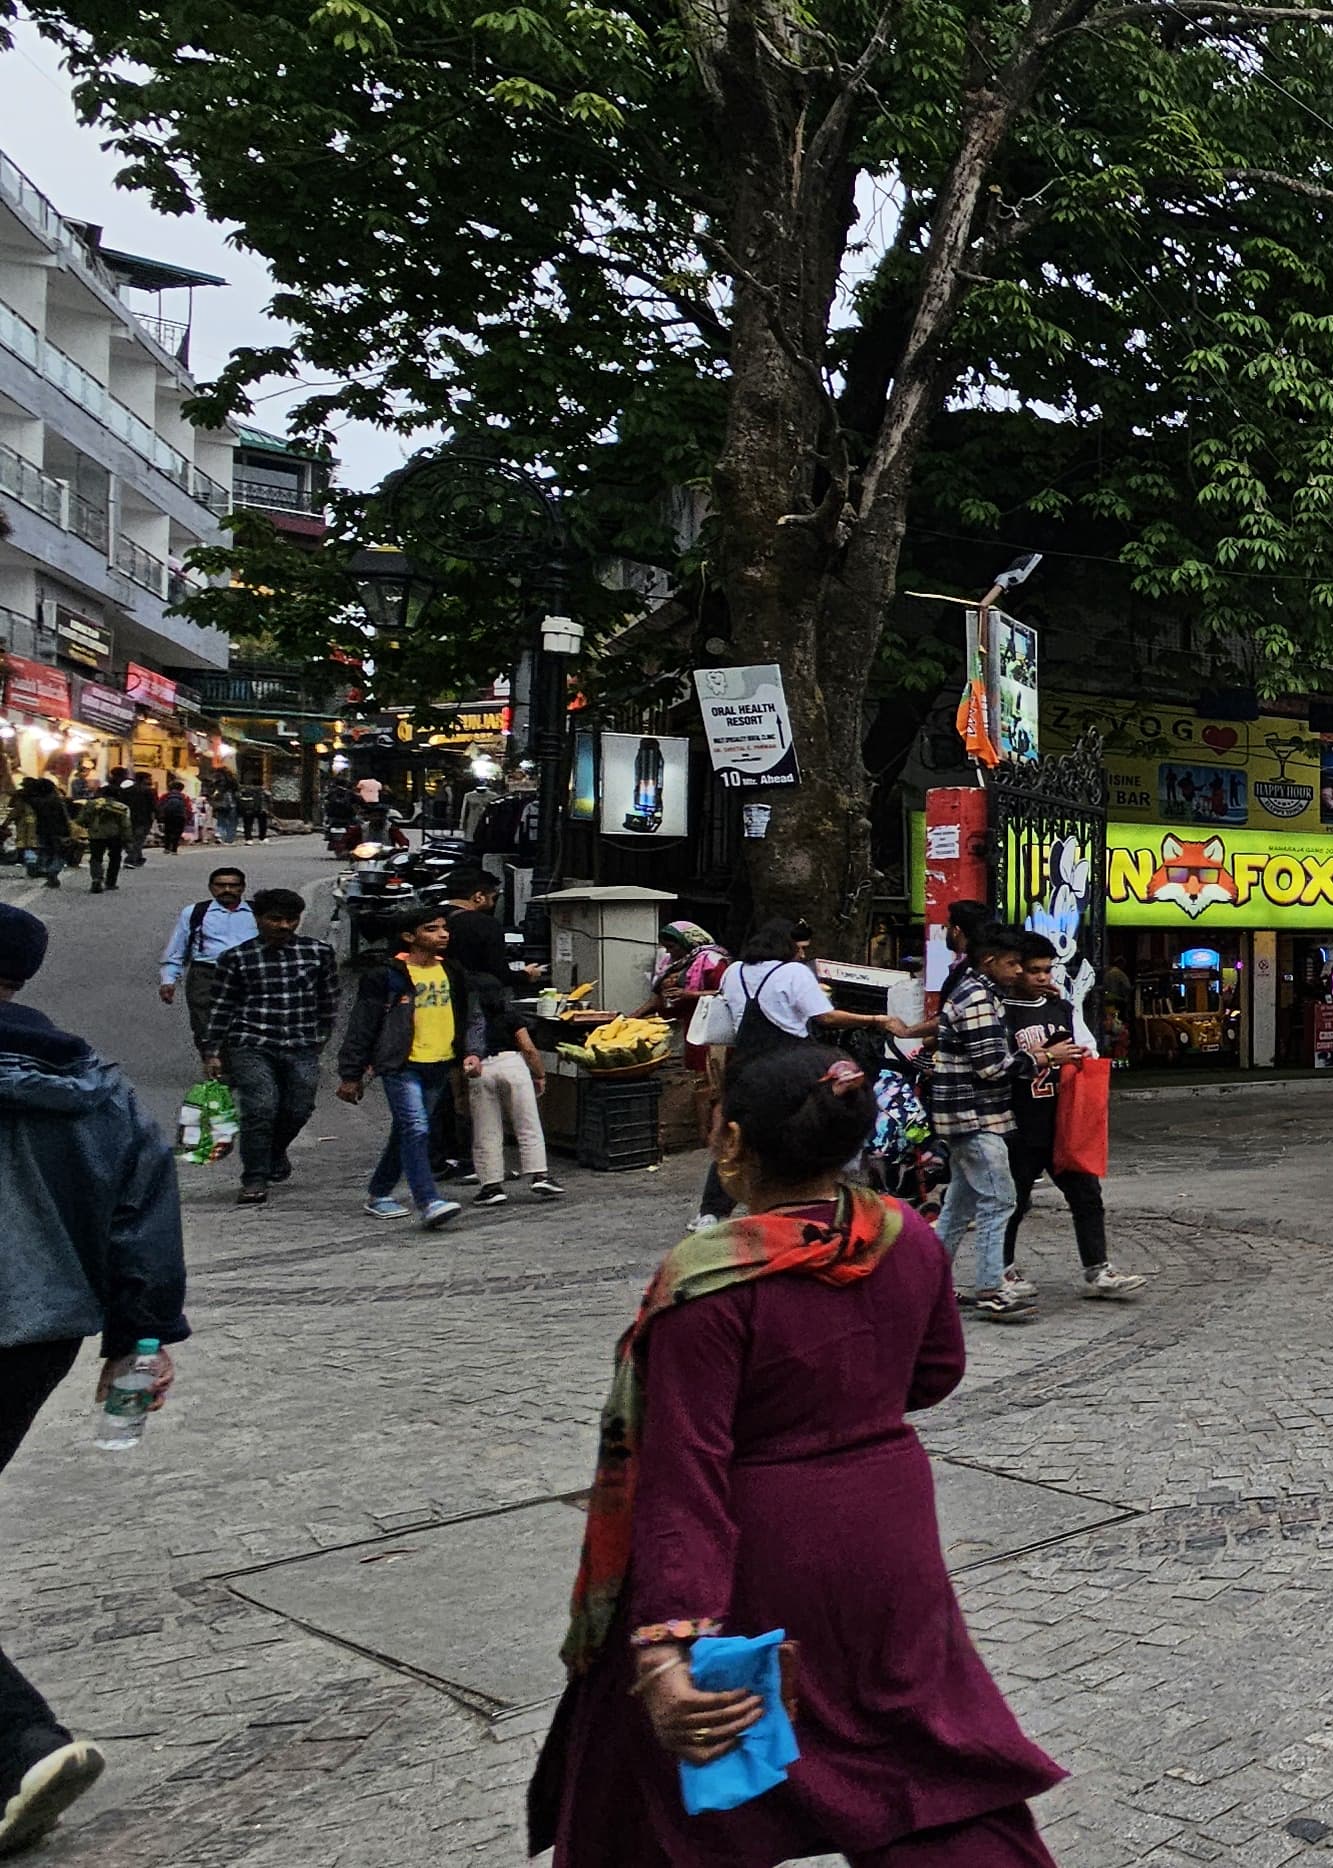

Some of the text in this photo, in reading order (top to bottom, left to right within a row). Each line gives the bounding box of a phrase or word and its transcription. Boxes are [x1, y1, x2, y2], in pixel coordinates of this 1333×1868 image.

[711, 703, 777, 718] ORAL HEALTH
[726, 715, 764, 727] RESORT
[720, 771, 795, 788] 10 Ahead
[1108, 774, 1142, 787] ISINE
[1116, 791, 1151, 806] BAR
[1255, 783, 1313, 800] HAPPY HOUR
